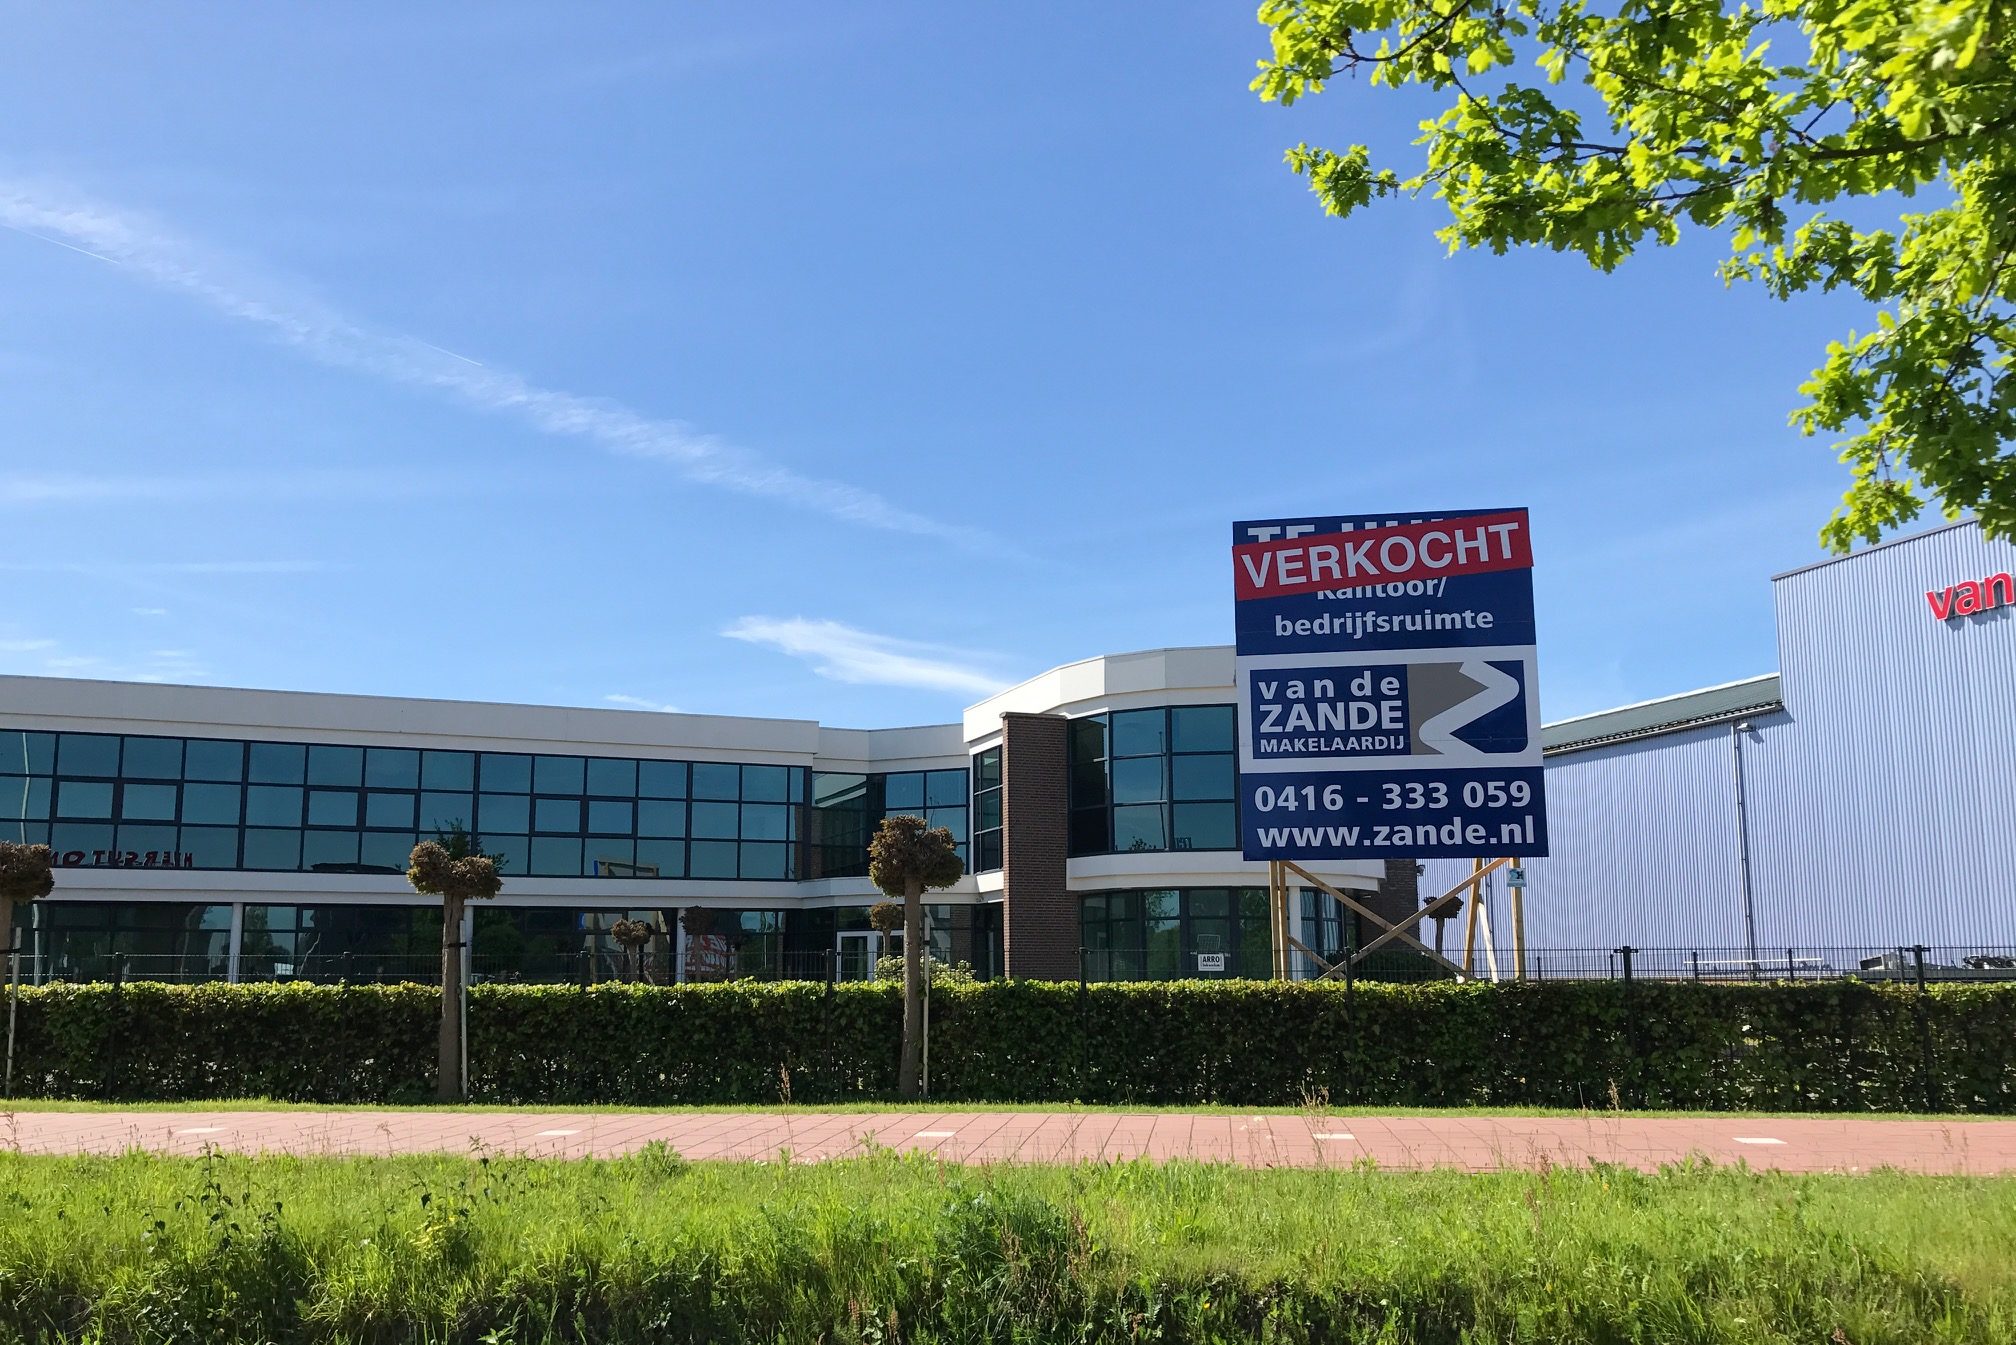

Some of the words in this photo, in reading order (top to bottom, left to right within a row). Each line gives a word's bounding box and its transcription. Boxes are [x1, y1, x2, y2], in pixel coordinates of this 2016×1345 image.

[1241, 522, 1519, 589] VERKOCHT
[1925, 572, 2014, 620] van
[1275, 609, 1494, 639] bedrijfsruimte
[1258, 679, 1335, 700] van
[1350, 670, 1400, 698] de
[1259, 700, 1404, 733] ZANDE
[1260, 735, 1405, 753] MAKELAARDIJ
[1254, 784, 1344, 812] 0416
[1382, 782, 1449, 810] 333
[1462, 780, 1531, 808] 059
[1256, 815, 1535, 848] www.zande.nl
